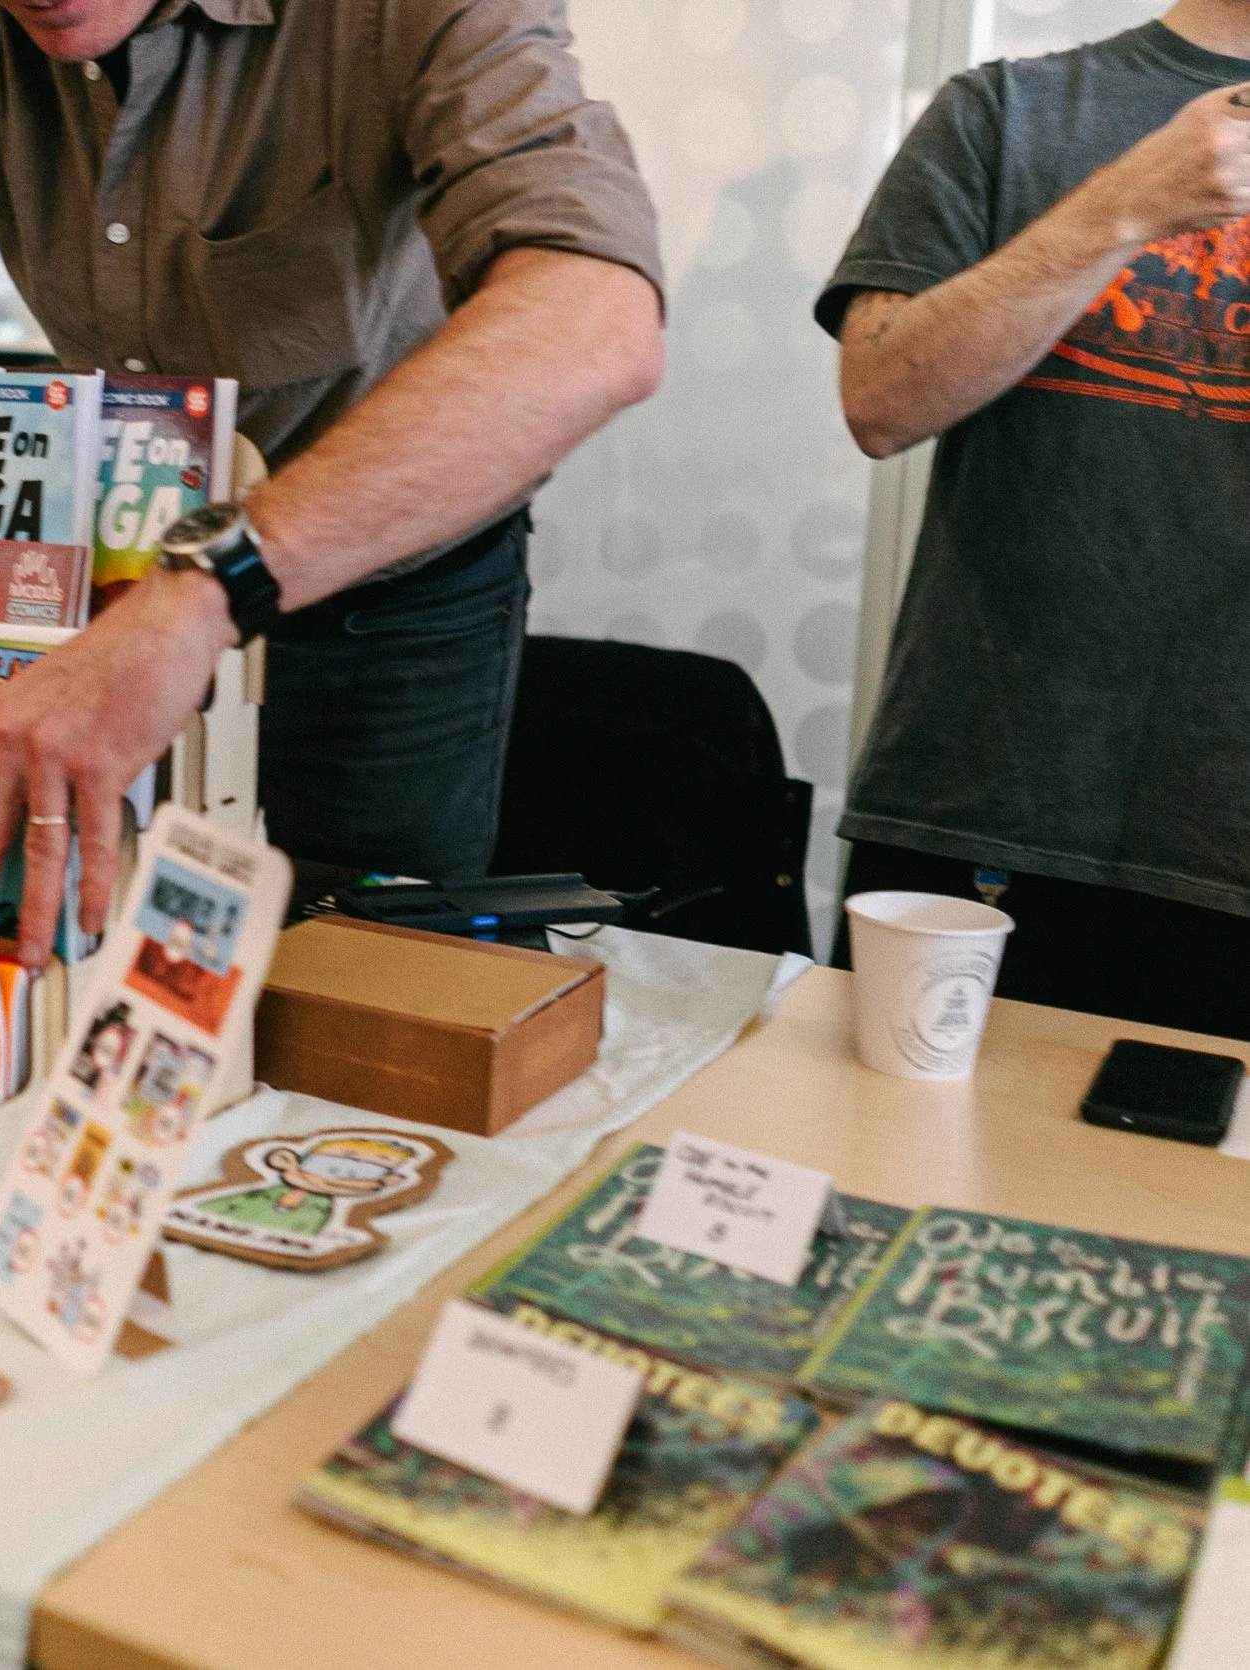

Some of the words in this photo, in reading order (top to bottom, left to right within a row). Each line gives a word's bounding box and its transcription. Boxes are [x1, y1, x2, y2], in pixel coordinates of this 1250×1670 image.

[13, 431, 48, 458] on
[101, 419, 153, 483] FE
[147, 436, 190, 466] on
[100, 482, 183, 553] GA
